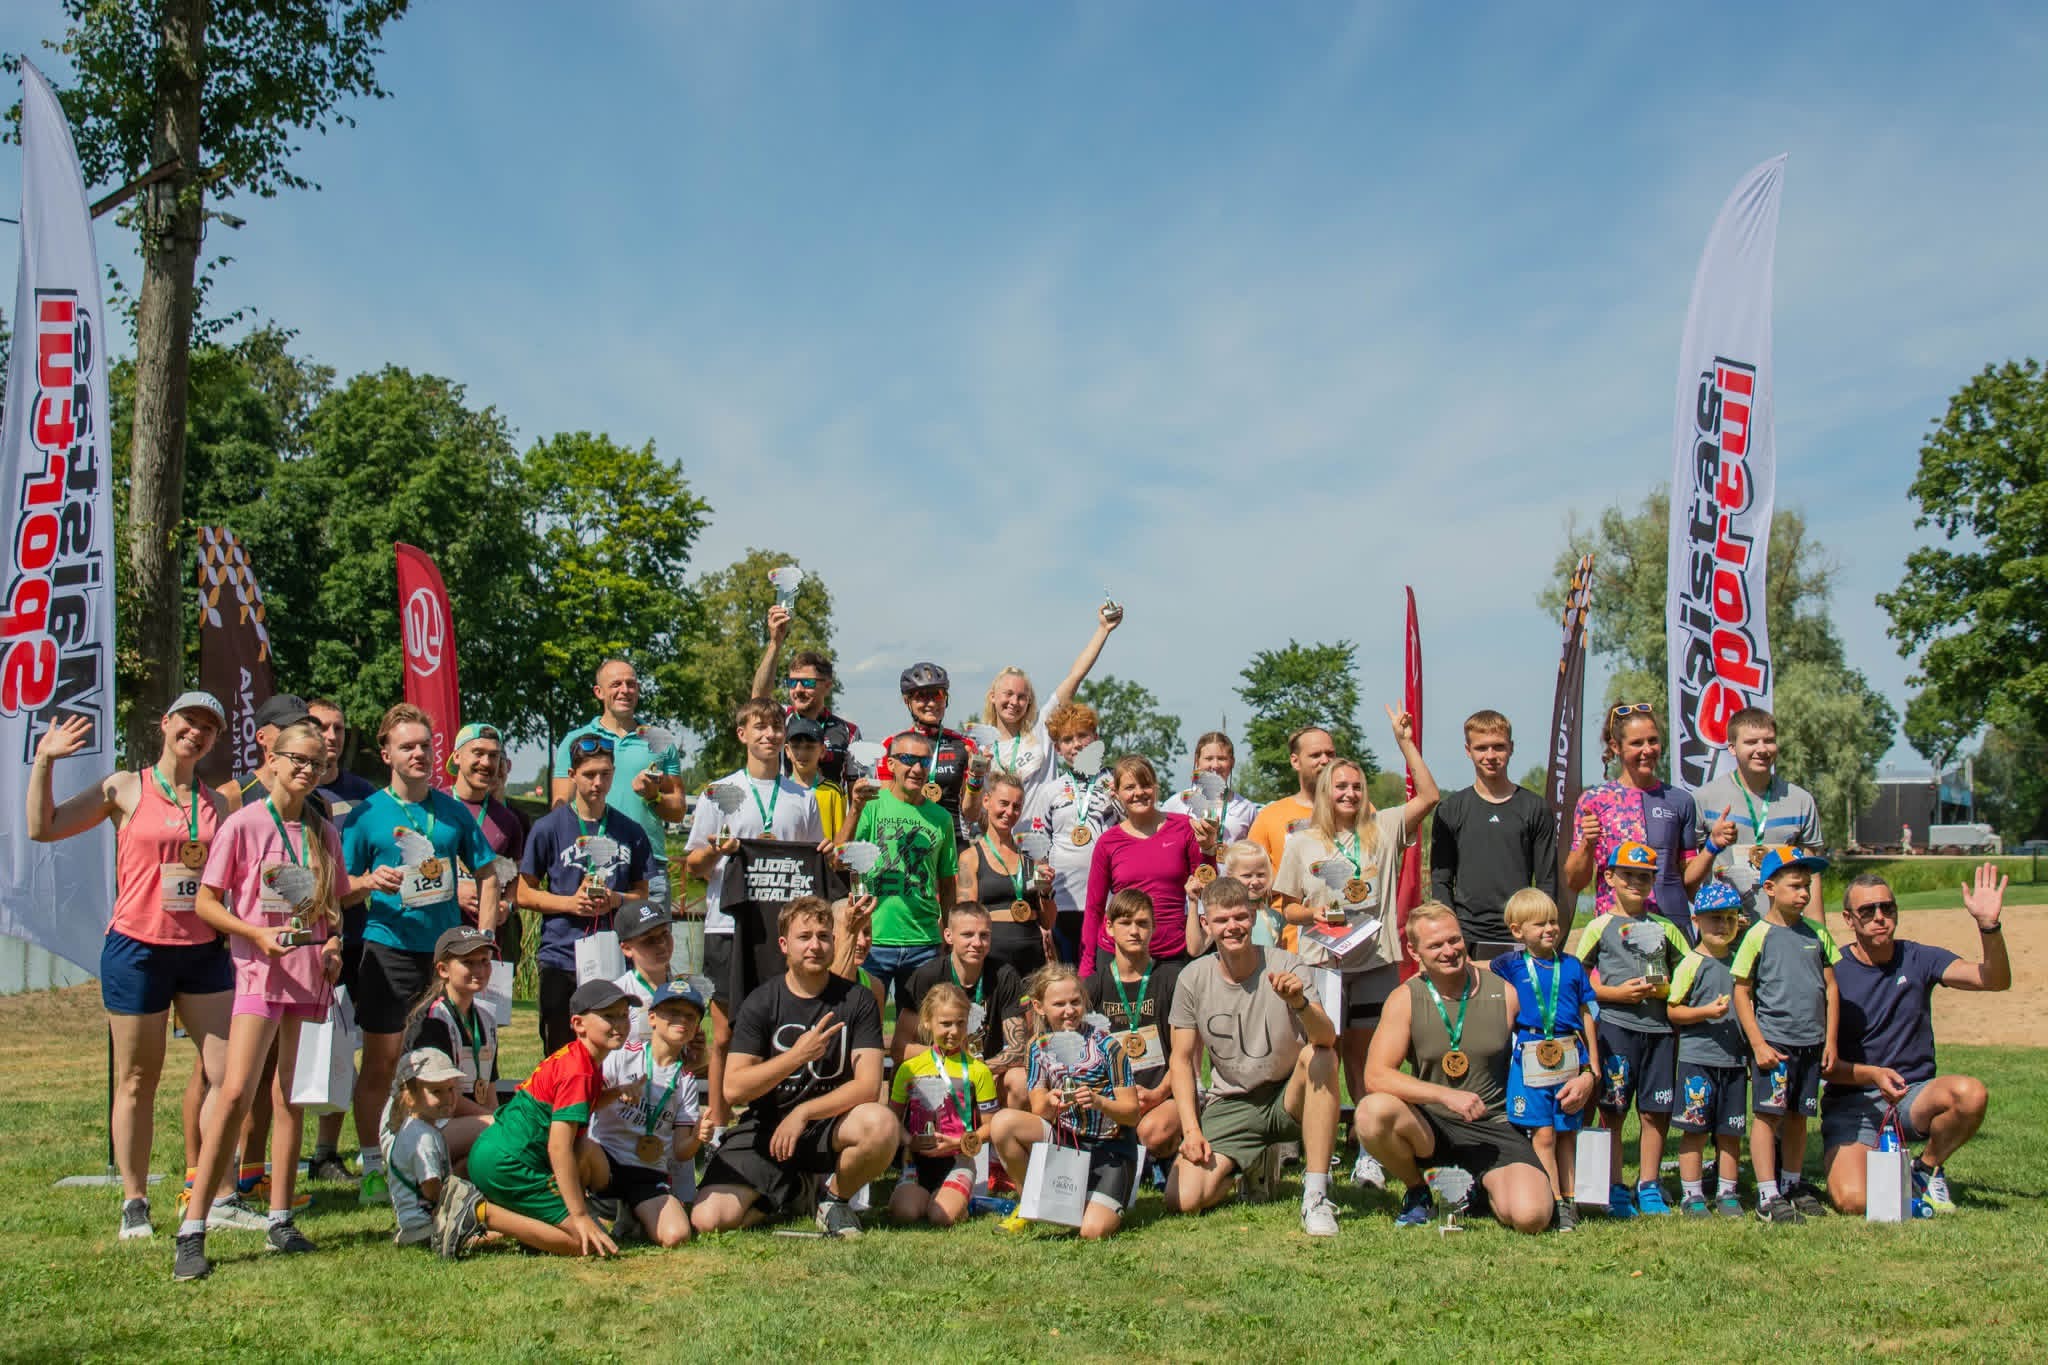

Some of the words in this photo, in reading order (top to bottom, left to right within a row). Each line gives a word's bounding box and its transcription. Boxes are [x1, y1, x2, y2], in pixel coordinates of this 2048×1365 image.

[935, 764, 956, 774] art
[413, 876, 442, 892] 123
[744, 872, 814, 889] OBULĖK
[1207, 1013, 1272, 1060] SU
